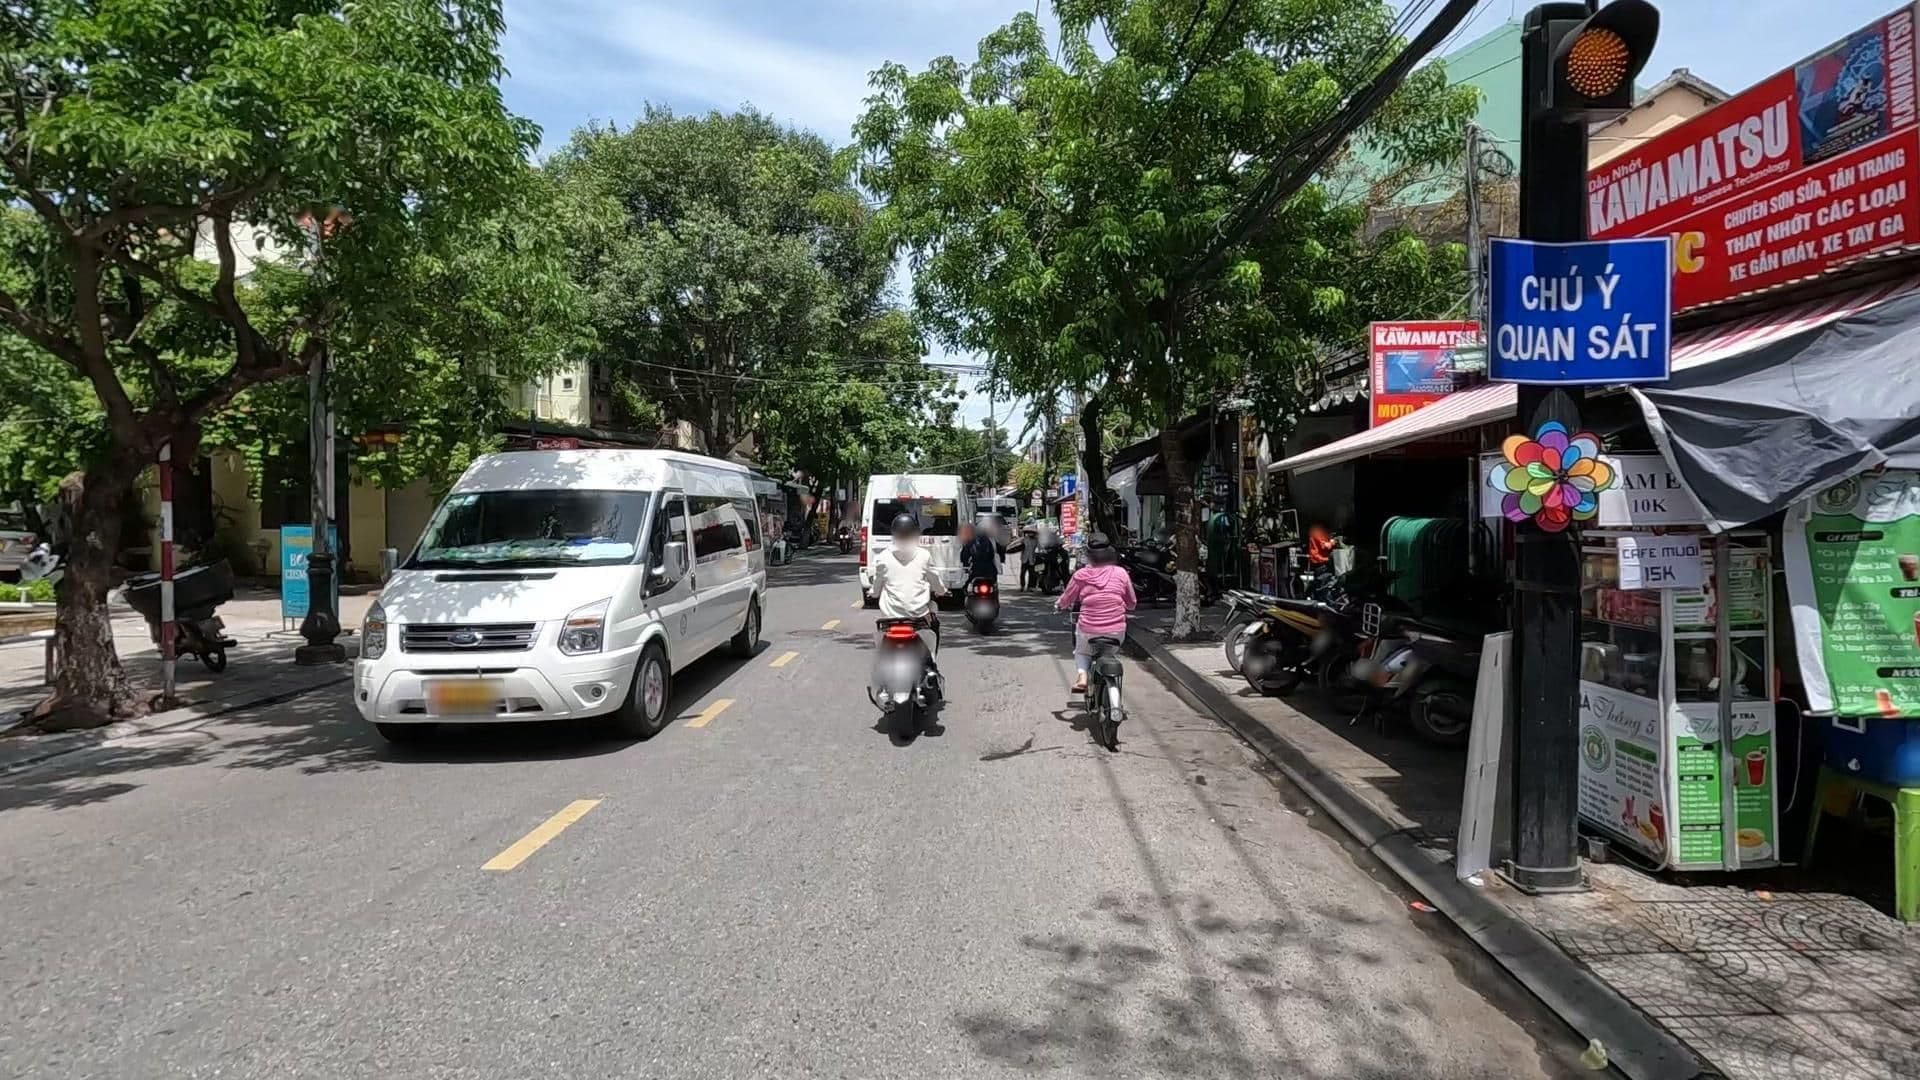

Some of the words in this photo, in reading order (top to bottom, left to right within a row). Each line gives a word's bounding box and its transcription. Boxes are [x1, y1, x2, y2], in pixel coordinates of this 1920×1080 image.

[1888, 10, 1915, 129] KAWAMATSU
[1589, 100, 1790, 236] KAWAMATSU
[1734, 159, 1790, 188] Technology
[1859, 147, 1905, 181] TRANG
[1725, 228, 1763, 256] THAY
[1817, 199, 1854, 227] CÁC
[1860, 180, 1906, 213] LOẠI
[1729, 264, 1747, 282] XE
[1822, 232, 1843, 255] XE
[1848, 222, 1876, 246] TAY
[1879, 214, 1905, 238] GA
[1521, 265, 1583, 311] CHÚ
[1595, 263, 1621, 310] Ý
[1497, 324, 1576, 362] QUAN
[1587, 313, 1657, 360] SÁT
[1377, 404, 1414, 418] MOTO
[1633, 498, 1667, 513] 10K
[1622, 547, 1657, 560] CAFE
[1645, 566, 1676, 581] 15K
